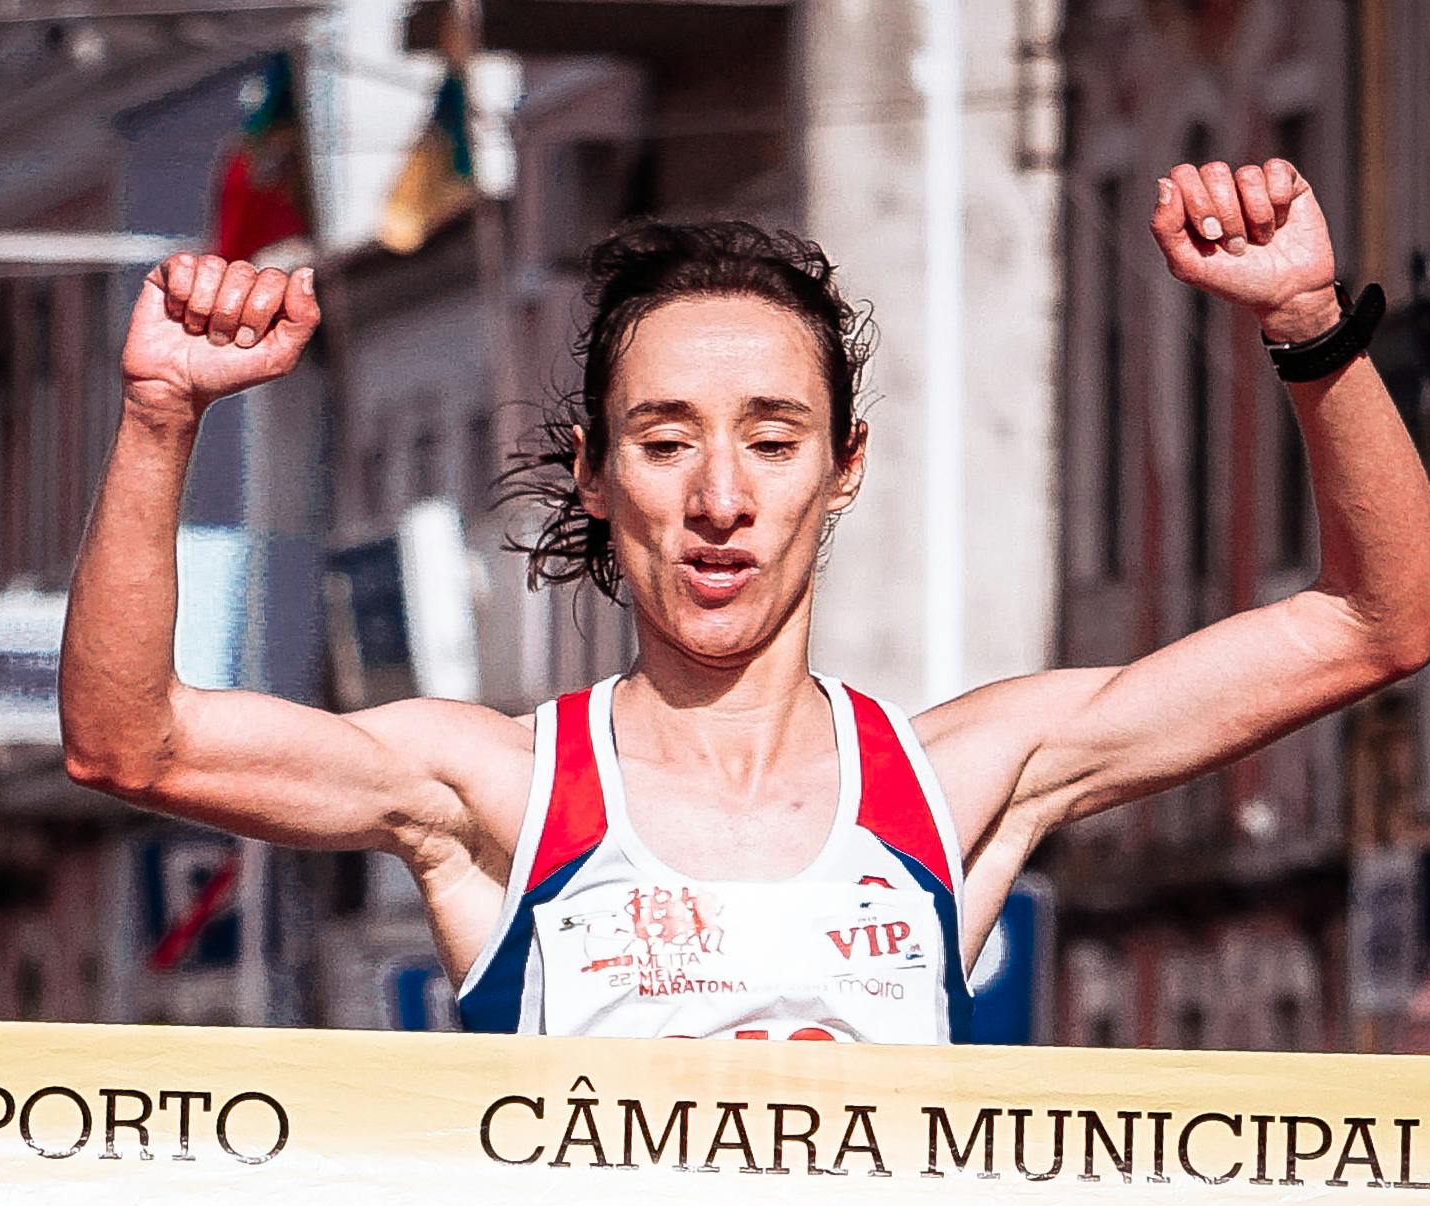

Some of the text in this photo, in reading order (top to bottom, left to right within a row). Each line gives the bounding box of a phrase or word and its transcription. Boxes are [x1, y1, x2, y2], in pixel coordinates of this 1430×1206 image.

[826, 921, 911, 960] VIP
[639, 968, 686, 984] MEIA
[639, 980, 747, 996] MARATONA
[479, 1076, 892, 1176] CÂMARA
